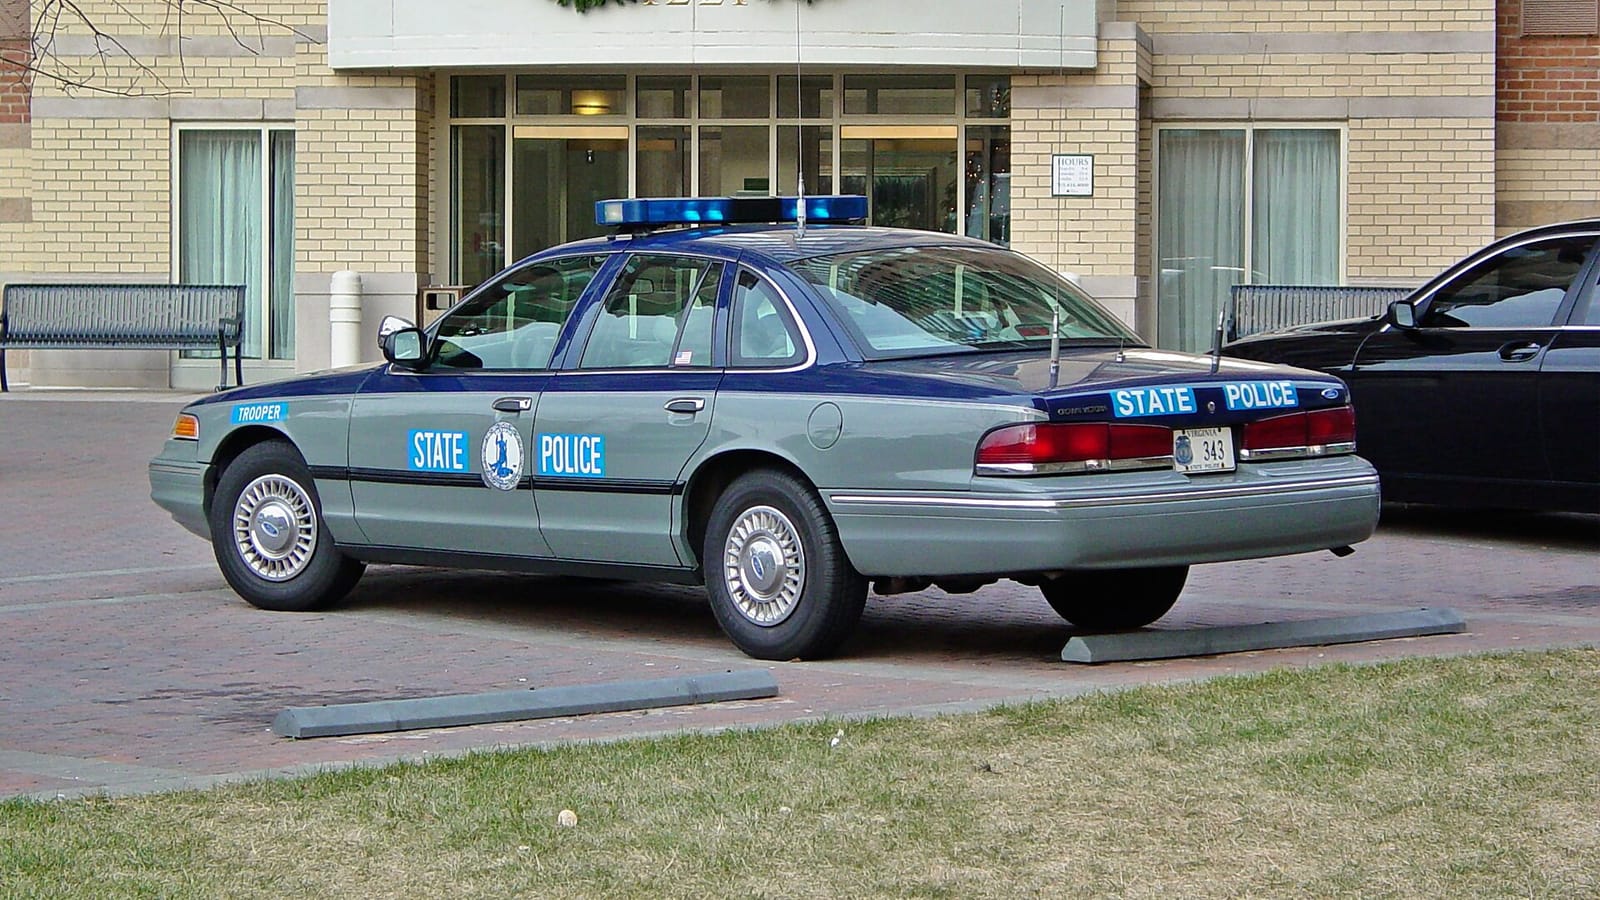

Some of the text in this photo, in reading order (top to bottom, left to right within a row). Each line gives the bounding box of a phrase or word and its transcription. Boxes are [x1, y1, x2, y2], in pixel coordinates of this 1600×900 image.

[1057, 157, 1089, 166] HOURS
[1115, 387, 1193, 416] STATE
[1226, 382, 1295, 409] POLICE
[238, 404, 281, 421] TROOPER
[1186, 428, 1218, 438] VIRGINIA
[413, 431, 463, 470] STATE
[541, 435, 601, 473] POLICE
[1202, 439, 1225, 462] 343
